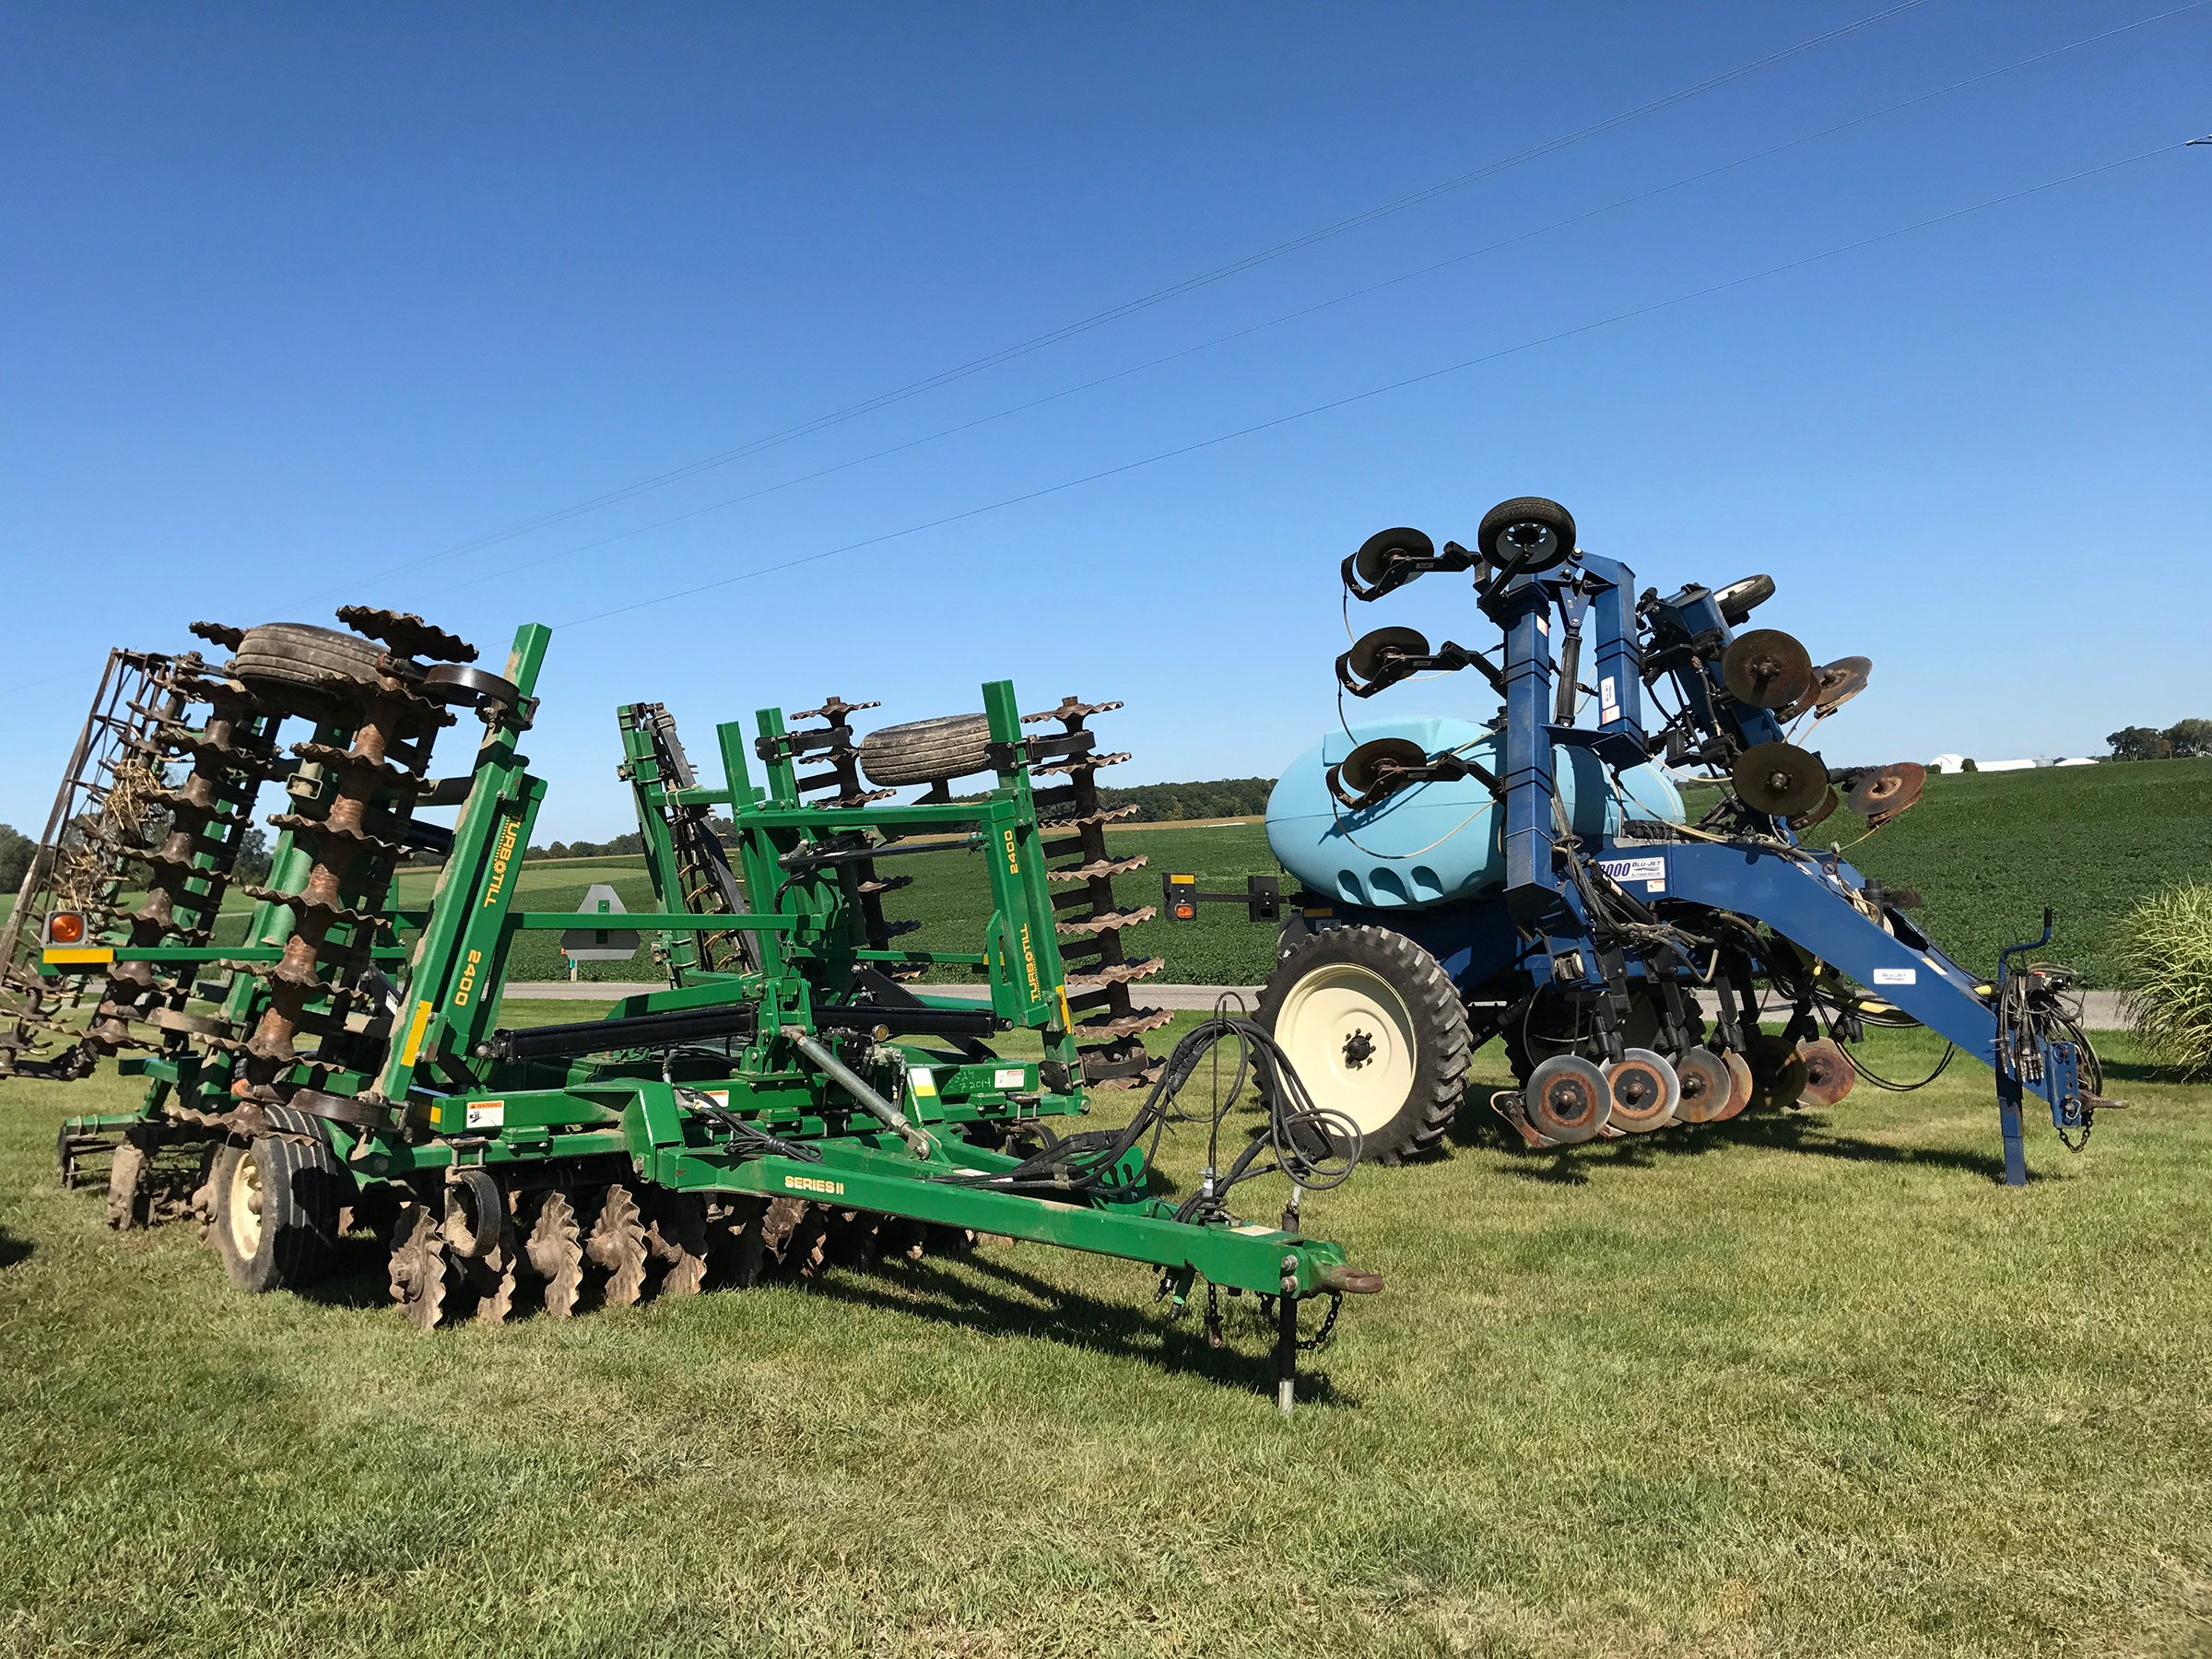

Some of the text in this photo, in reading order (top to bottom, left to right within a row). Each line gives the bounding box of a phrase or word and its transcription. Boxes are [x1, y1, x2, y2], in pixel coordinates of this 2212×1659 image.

[483, 813, 524, 908] TURBOTILL
[1004, 830, 1018, 875] 2400
[454, 949, 482, 1006] 2400
[1020, 923, 1039, 1004] TURBOTILL
[969, 1077, 992, 1089] 2014
[784, 1175, 845, 1195] SERIES II
